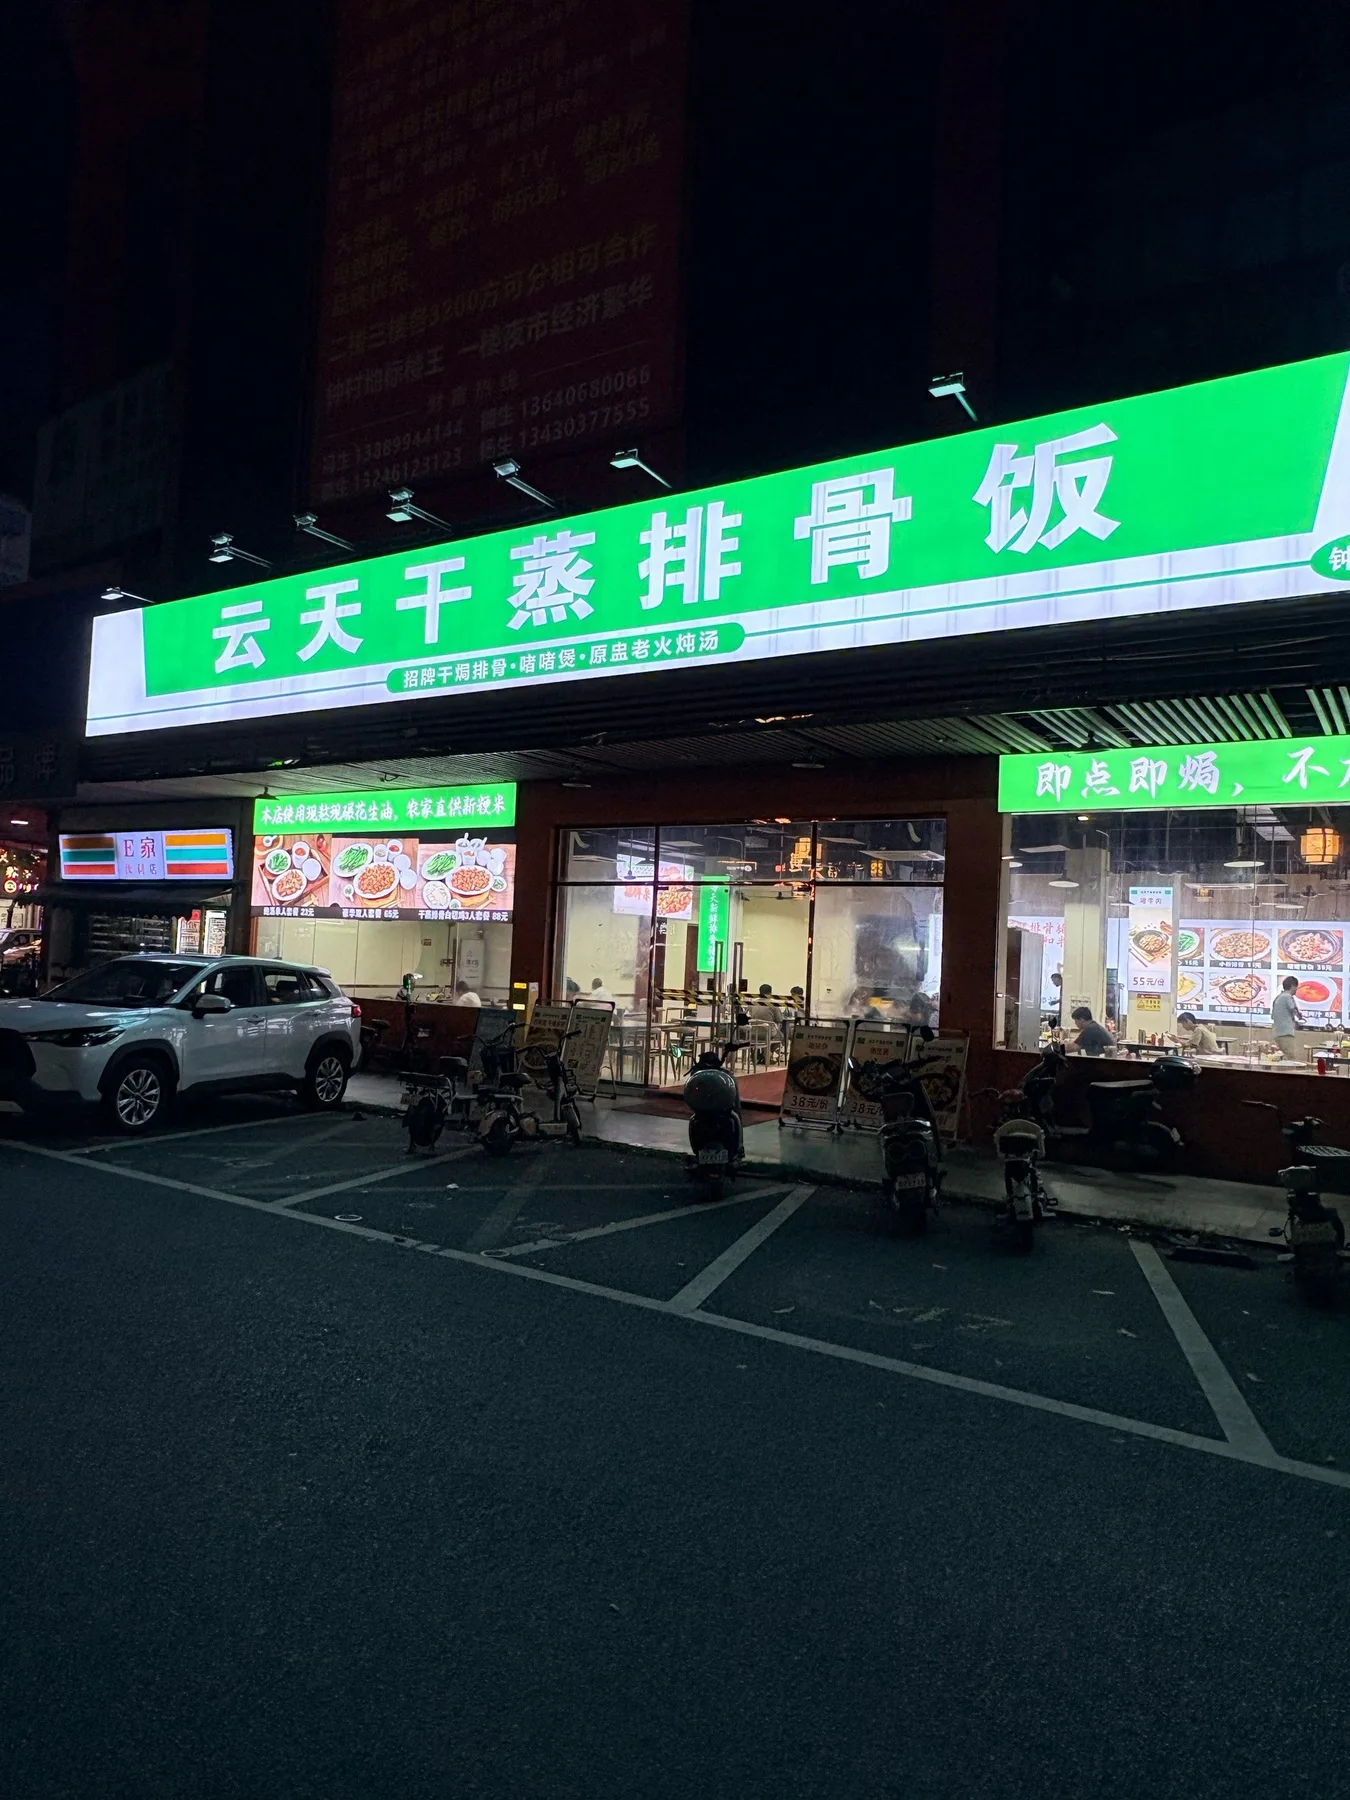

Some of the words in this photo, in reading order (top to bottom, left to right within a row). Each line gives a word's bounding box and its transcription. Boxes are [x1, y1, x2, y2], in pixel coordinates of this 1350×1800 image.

[518, 402, 650, 449] 13430377555
[211, 422, 1122, 676] 云天干蒸排骨饭
[1035, 745, 1350, 803] 即点即焗，不
